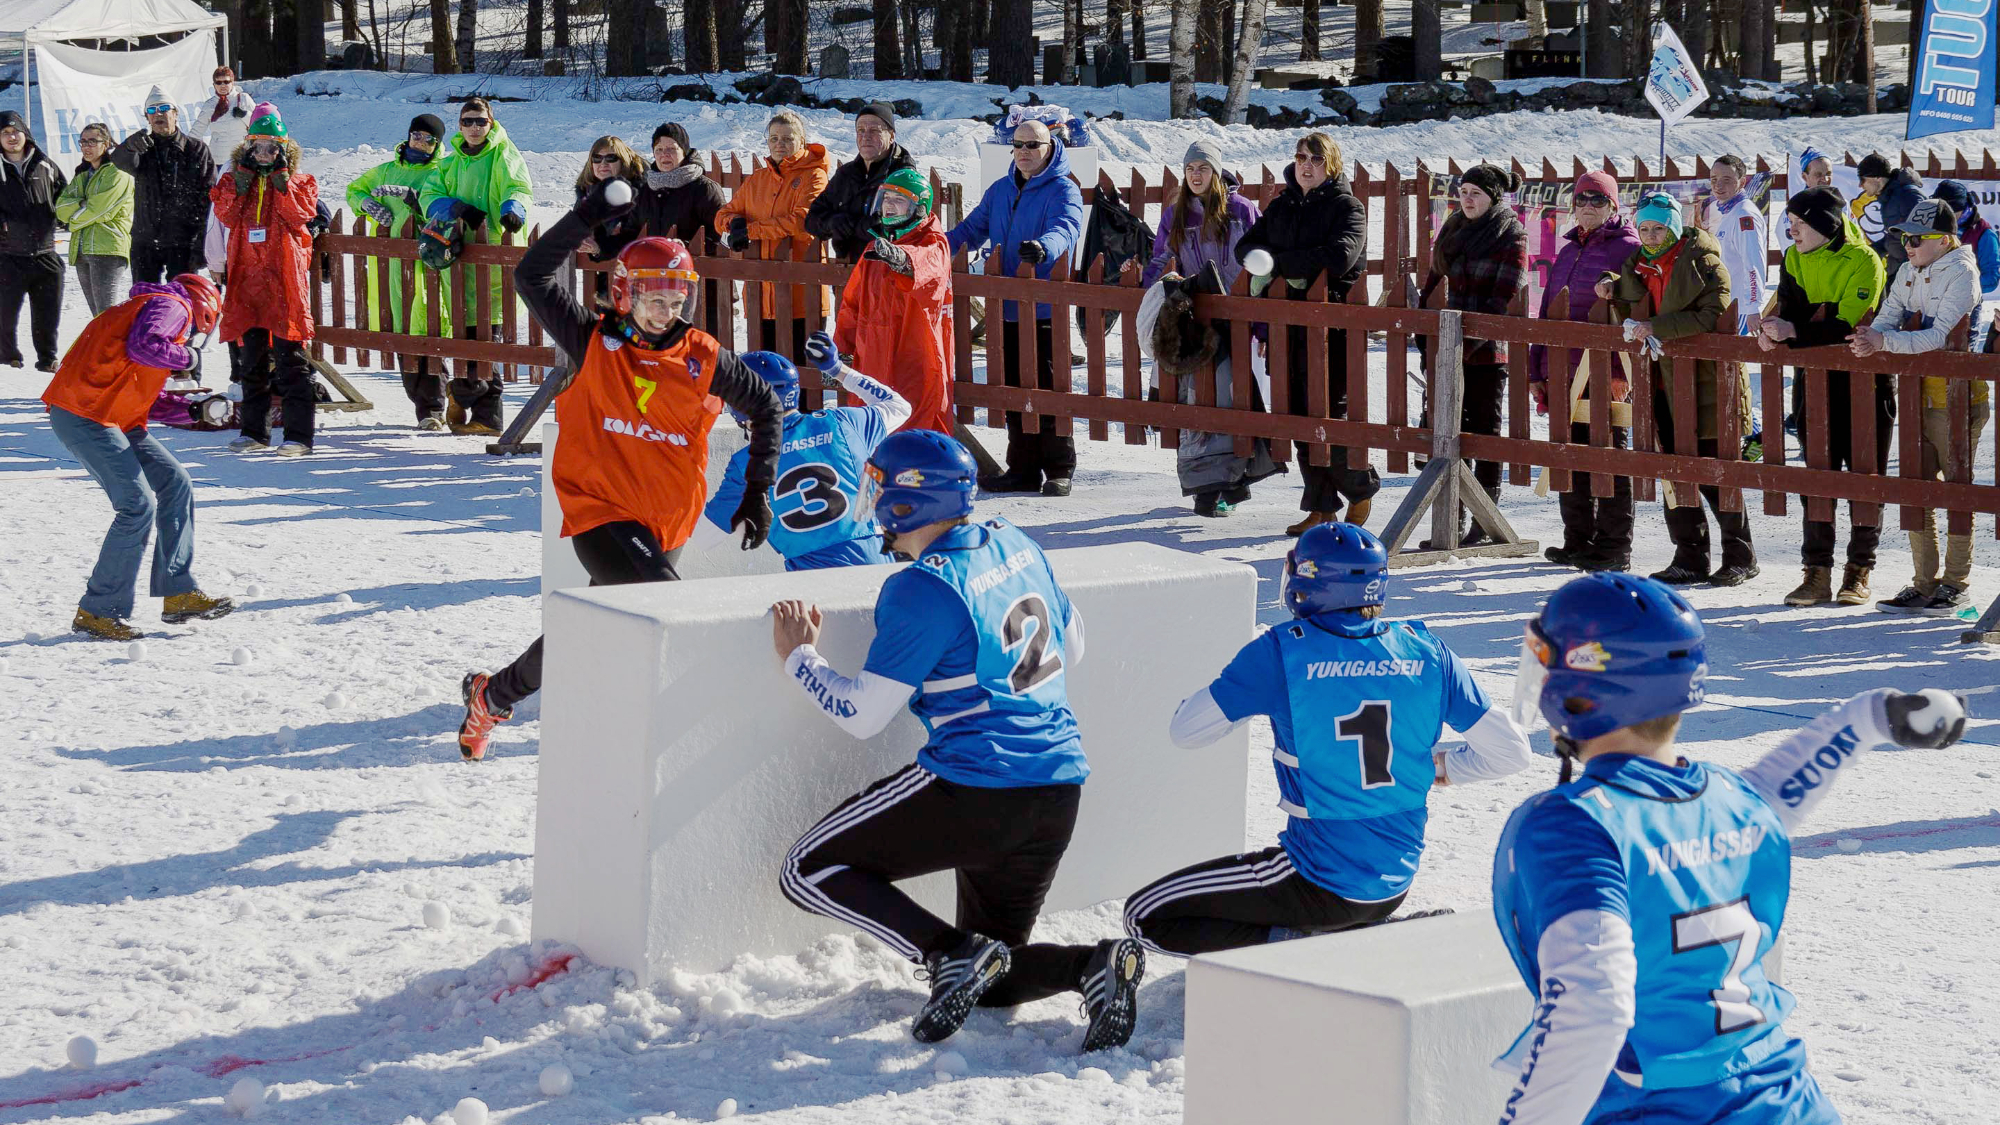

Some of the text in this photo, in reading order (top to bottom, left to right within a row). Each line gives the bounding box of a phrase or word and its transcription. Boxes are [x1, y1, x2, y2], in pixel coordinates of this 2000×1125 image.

[1532, 55, 1581, 63] FLINK
[1937, 87, 1976, 107] TOUR
[634, 375, 657, 414] 7
[782, 432, 833, 455] GASSEN
[773, 462, 850, 533] 3
[922, 553, 950, 574] 2
[969, 548, 1036, 596] YUKIGASSEN
[1001, 592, 1064, 696] 2
[1288, 624, 1305, 639] 1
[1306, 659, 1425, 681] YUKIGASSEN
[795, 662, 858, 718] FINLAND
[1334, 700, 1396, 790] 1
[1670, 893, 1767, 1036] 7
